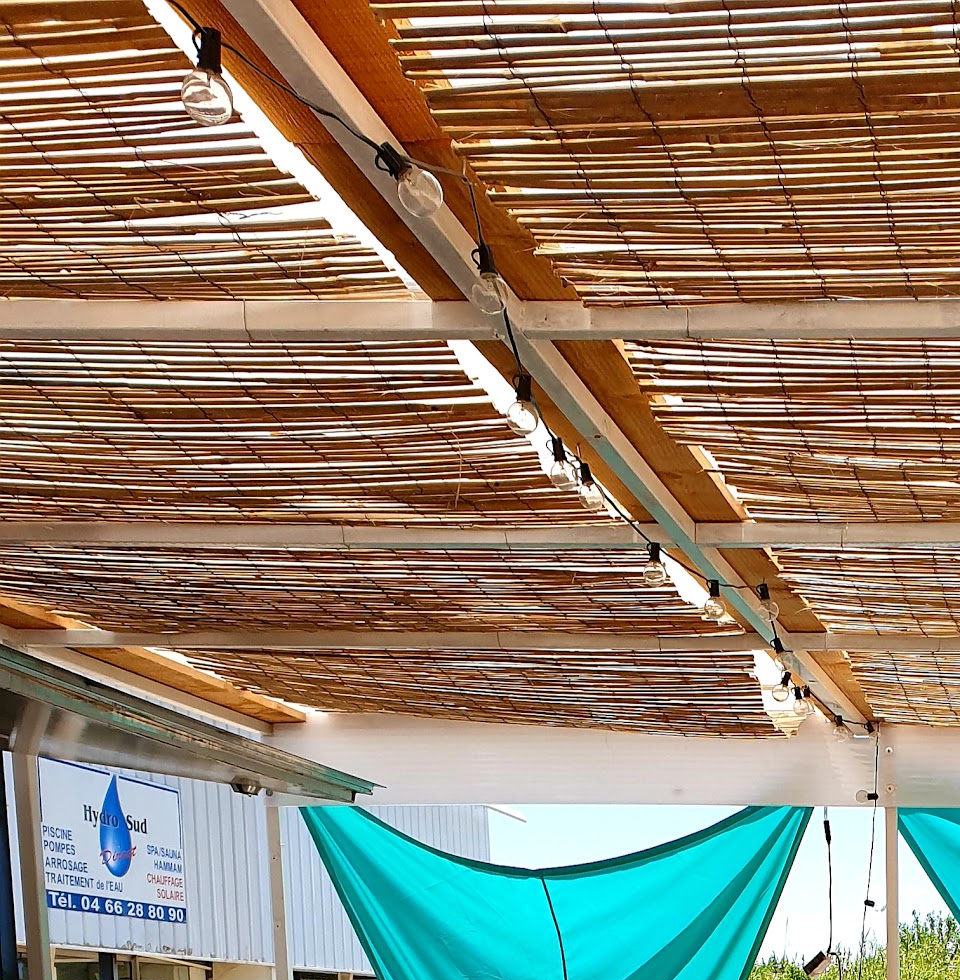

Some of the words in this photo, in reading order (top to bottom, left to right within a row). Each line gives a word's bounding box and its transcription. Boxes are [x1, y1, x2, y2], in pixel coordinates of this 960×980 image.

[83, 804, 119, 828] Hydro
[126, 814, 147, 834] Sud
[42, 825, 73, 841] PISCINE
[43, 840, 76, 856] POMPES
[146, 844, 182, 860] SPA/SAUNA
[45, 856, 88, 873] ARROSAGE
[153, 860, 182, 873] HAMMAM
[45, 872, 94, 888] TRAITEMENT
[96, 880, 105, 890] de
[106, 881, 124, 892] l'EAU
[146, 873, 183, 888] CHAUFFAGE
[156, 888, 184, 902] SOLAIRE
[48, 891, 77, 909] Tél.
[81, 895, 100, 912] 04
[104, 899, 123, 915] 66
[127, 902, 144, 917] 28
[148, 904, 165, 920] 80
[168, 908, 184, 922] 90
